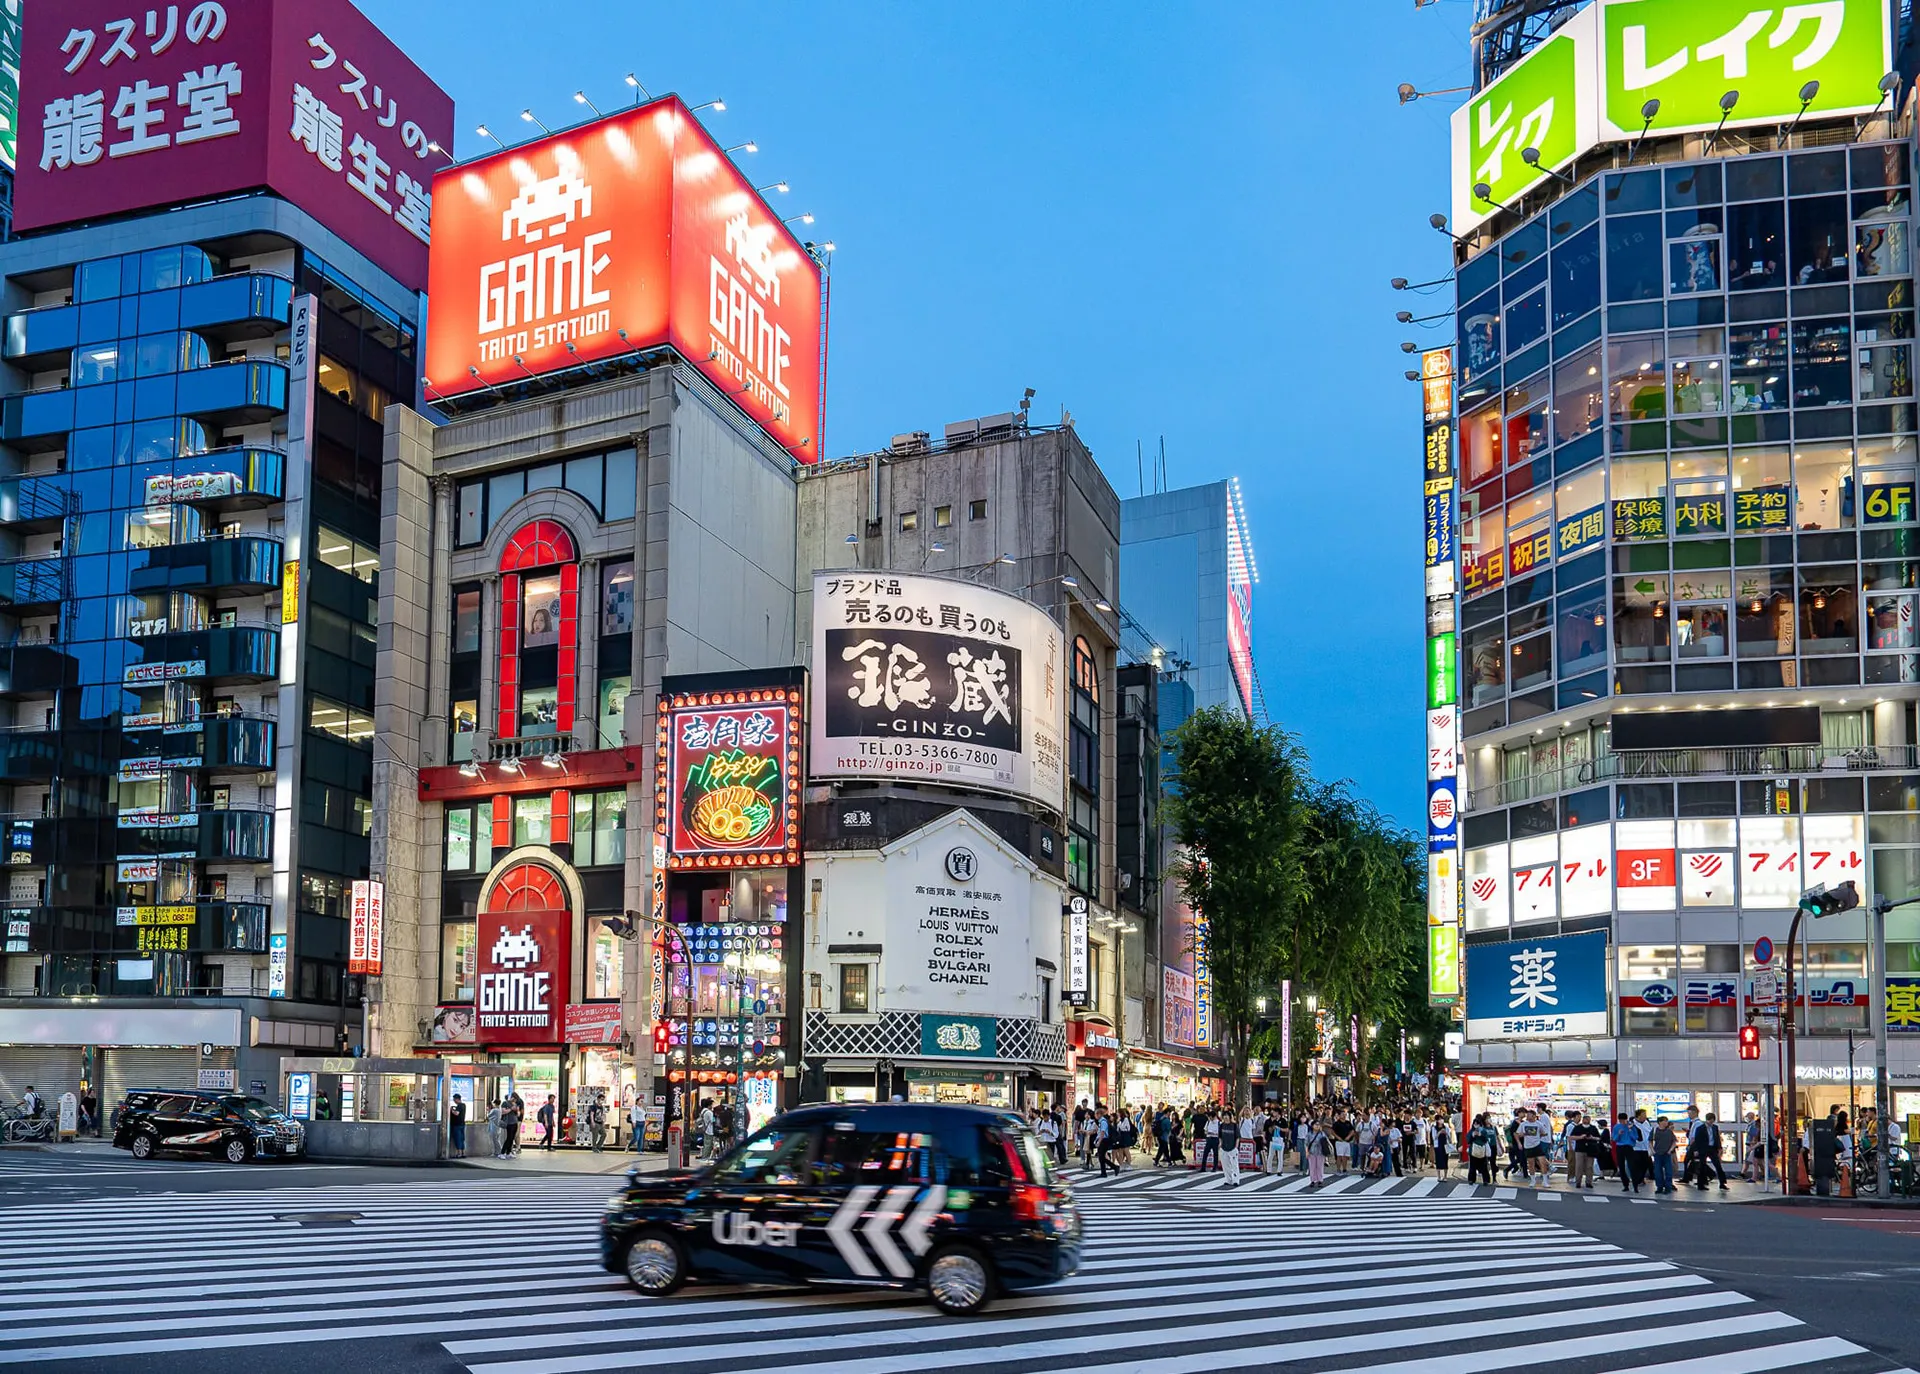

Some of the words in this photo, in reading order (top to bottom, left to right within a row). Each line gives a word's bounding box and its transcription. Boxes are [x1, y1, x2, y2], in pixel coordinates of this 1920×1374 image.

[60, 1, 227, 74] クスリの
[1622, 1, 1845, 90] レイク
[307, 33, 429, 158] クスリの
[39, 61, 242, 172] 龍生堂
[1477, 98, 1554, 184] レイク
[289, 82, 431, 244] 龍生堂
[479, 230, 611, 334] GAME
[479, 331, 528, 362] TAITO
[533, 310, 610, 349] STATION
[710, 256, 791, 397] GAME
[709, 333, 742, 381] TAITO
[746, 376, 789, 426] STATION
[1426, 432, 1437, 470] Table
[1437, 424, 1449, 474] Cheese
[1426, 481, 1439, 491] 7F
[1737, 493, 1786, 508] 予約
[1614, 500, 1663, 517] 保険
[1676, 502, 1723, 527] 内科
[1866, 487, 1911, 517] 6F
[1427, 499, 1437, 537] クリニック
[1440, 502, 1450, 560] プライマリケア
[1560, 510, 1603, 550] 夜間
[1614, 519, 1663, 535] 診療
[1737, 511, 1786, 524] 不要
[1426, 557, 1436, 565] 6F
[1513, 534, 1550, 571] 祝日
[1465, 553, 1503, 590] 土・日
[826, 580, 902, 596] ブランド品
[842, 639, 1012, 726] 銀蔵
[682, 712, 779, 749] 壱角家
[711, 755, 768, 777] ラーメン
[837, 757, 943, 773] http://ginzo.jp
[859, 742, 998, 766] TEL.03-5366-7800
[1431, 799, 1453, 819] 薬
[952, 853, 971, 876] 質
[1515, 859, 1607, 892] アイフル
[1631, 859, 1660, 880] 3F
[1748, 851, 1862, 873] アイフル
[653, 872, 664, 941] ラーメン
[915, 886, 956, 897] 高価買取
[963, 890, 1002, 901] 激安販売
[920, 919, 949, 931] LOUIS
[955, 922, 999, 934] VUITTON
[929, 906, 989, 920] HERMÈS
[933, 947, 985, 960] Cartier
[936, 934, 983, 946] ROLEX
[1074, 916, 1083, 987] 質・買取・販売
[928, 960, 991, 973] BVLGARI
[1435, 934, 1452, 981] レイク
[480, 972, 550, 1012] GAME
[929, 973, 988, 985] CHANEL
[1509, 948, 1558, 1008] 薬
[480, 1014, 506, 1027] TAITO
[508, 1014, 548, 1026] STATION
[1503, 1018, 1565, 1033] ミネドラッグ
[294, 1079, 302, 1094] P
[1795, 1066, 1889, 1080] PANDOR
[712, 1211, 802, 1248] Uber
